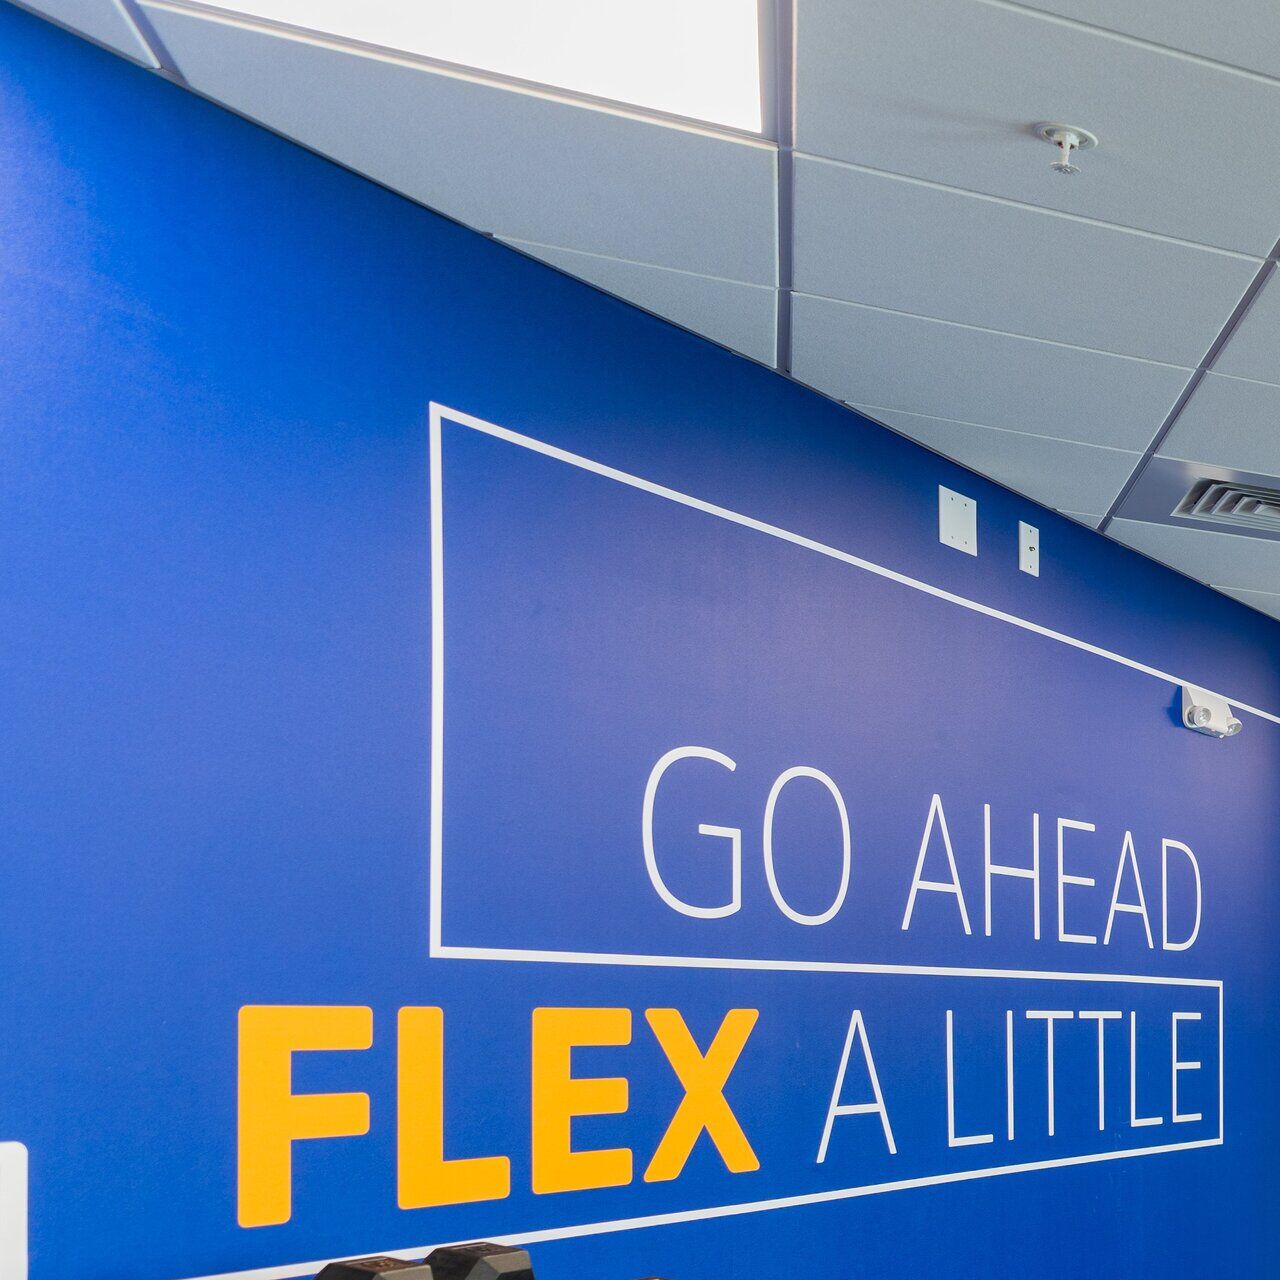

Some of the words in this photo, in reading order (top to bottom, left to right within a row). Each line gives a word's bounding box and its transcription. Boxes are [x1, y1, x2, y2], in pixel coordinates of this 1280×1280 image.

[641, 745, 852, 926] GO
[901, 793, 1202, 951] AHEAD
[238, 1005, 761, 1228] FLEX
[816, 1009, 897, 1164] A
[946, 1009, 1202, 1148] LITTLE
